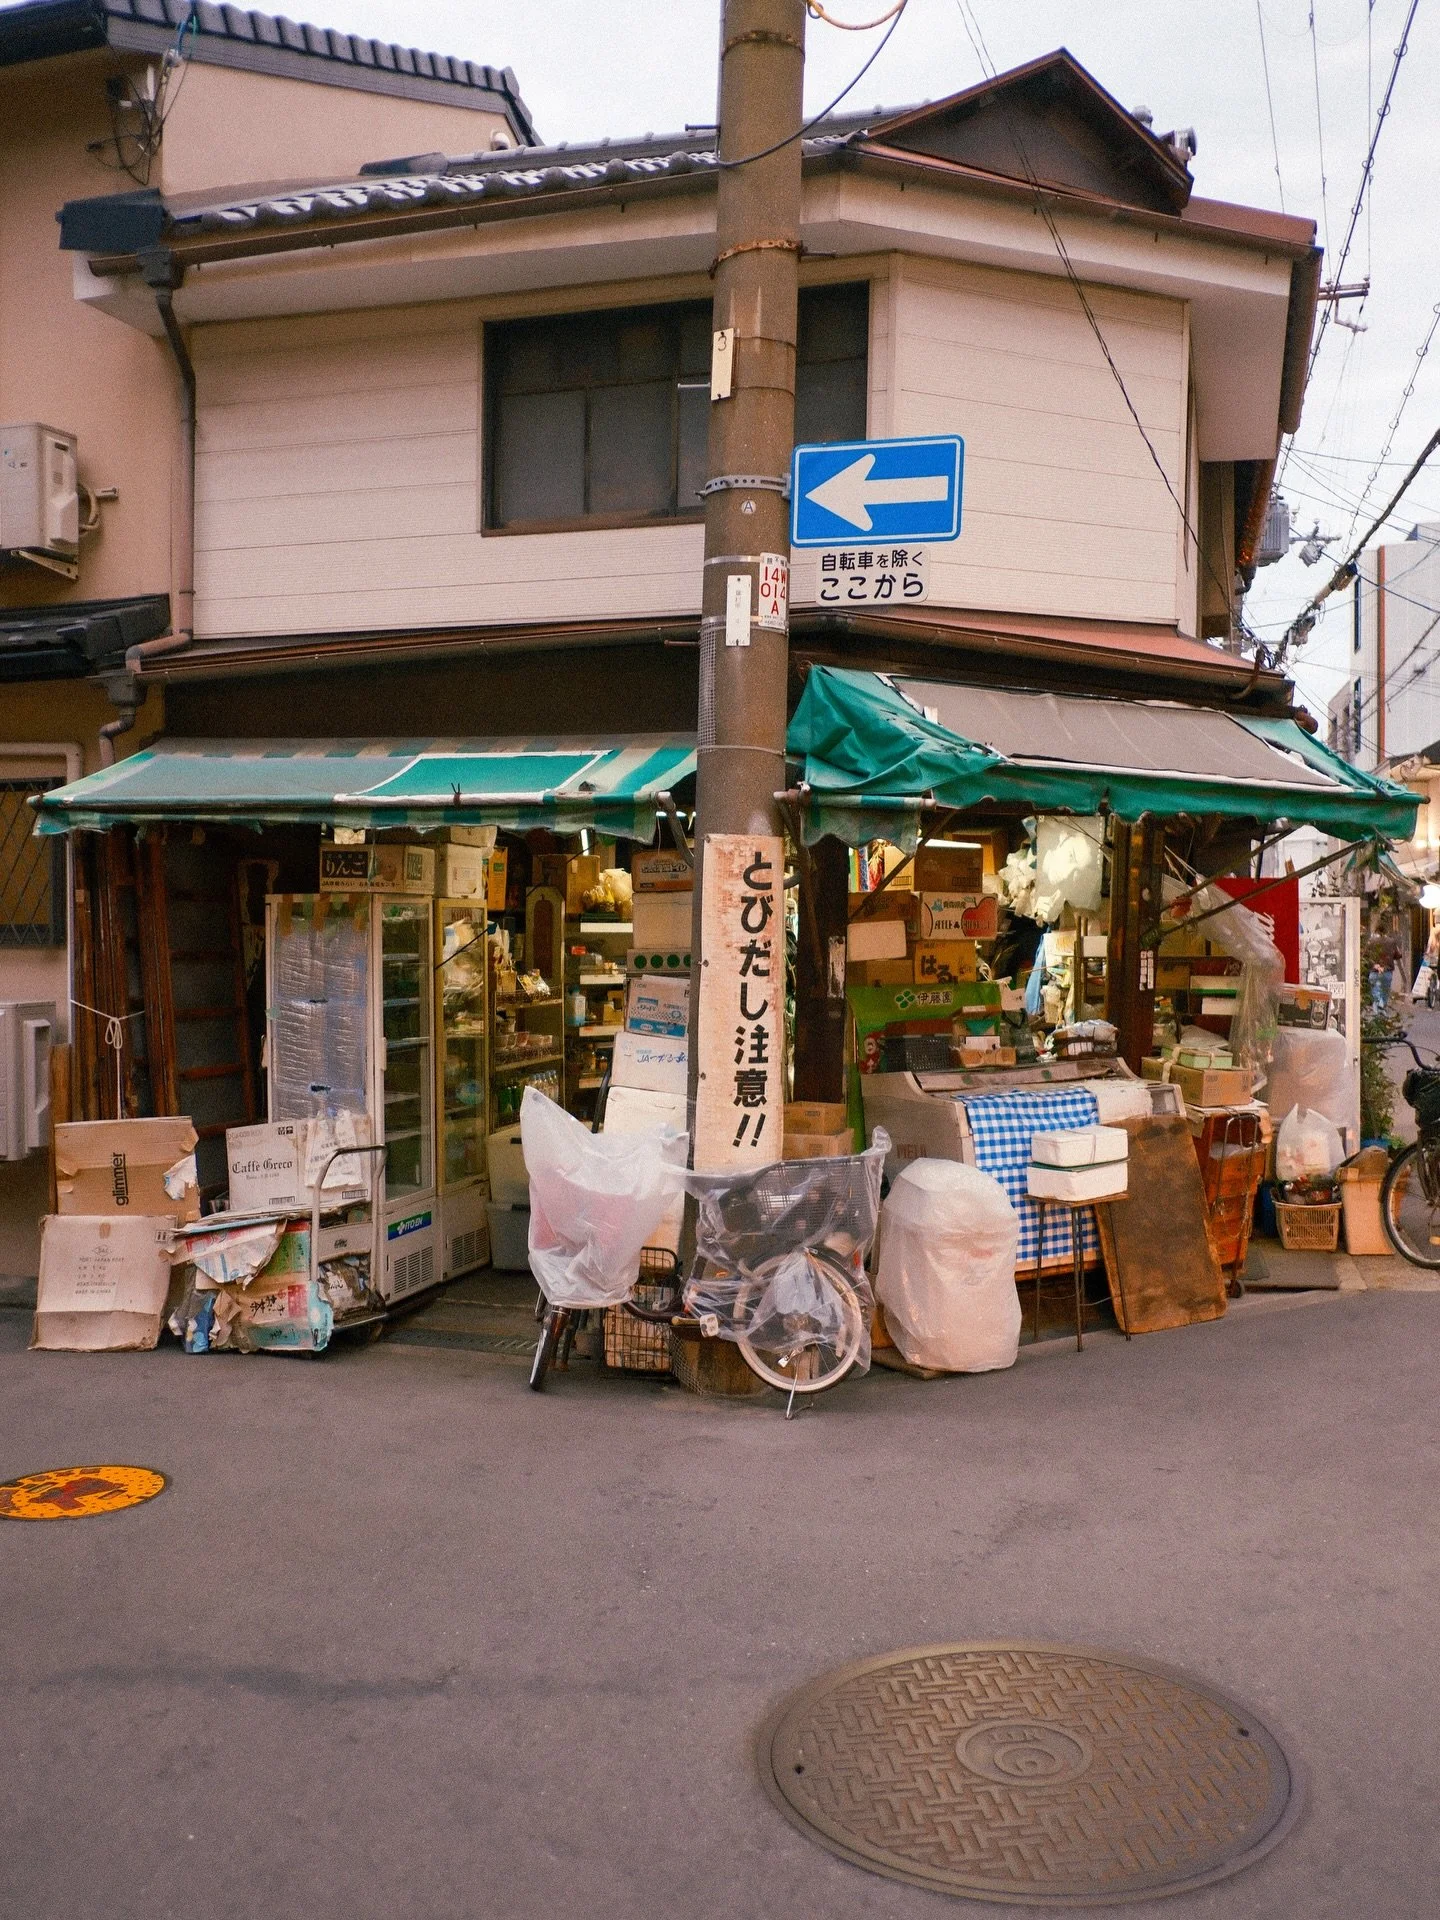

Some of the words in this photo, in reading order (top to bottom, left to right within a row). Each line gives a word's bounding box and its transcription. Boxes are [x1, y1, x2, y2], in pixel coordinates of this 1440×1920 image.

[717, 336, 728, 352] 3
[743, 501, 754, 513] A
[821, 548, 923, 571] 自転車を除く
[820, 573, 924, 601] ここから
[771, 600, 780, 615] A
[325, 860, 366, 876] りんご
[917, 990, 952, 1005] 伊藤園
[262, 1157, 293, 1171] Greco
[112, 1152, 130, 1206] glimmer
